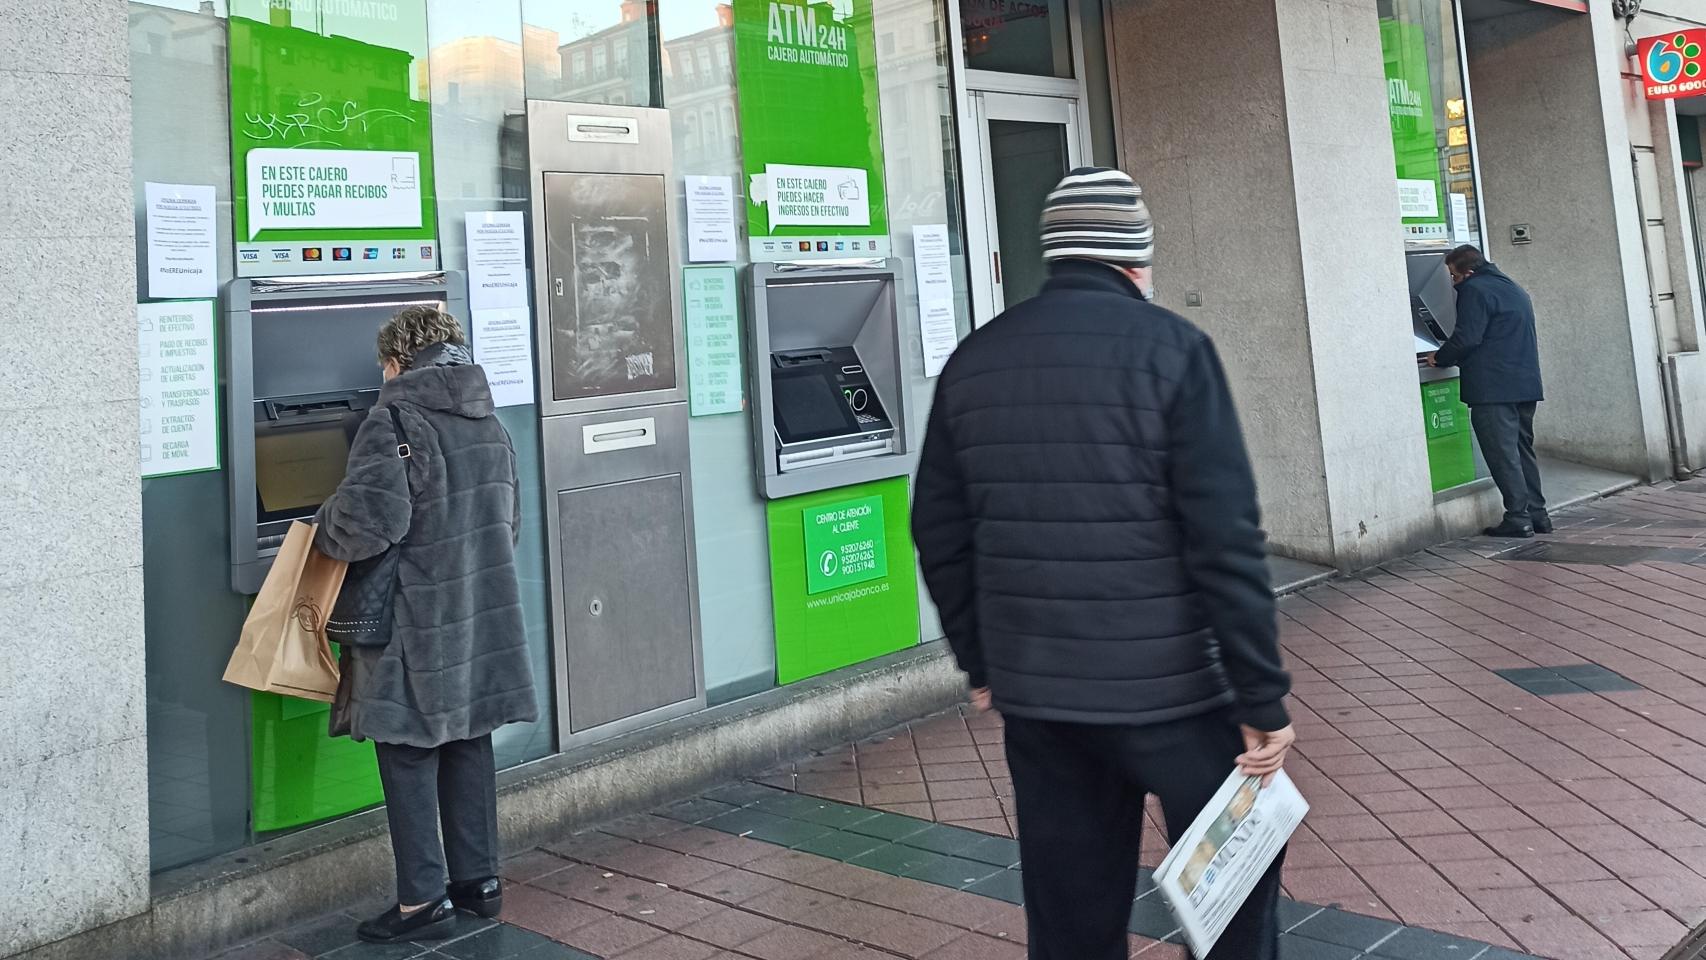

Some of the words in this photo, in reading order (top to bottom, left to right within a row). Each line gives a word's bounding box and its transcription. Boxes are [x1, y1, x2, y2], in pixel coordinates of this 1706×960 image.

[768, 2, 818, 47] ATM
[818, 24, 847, 51] 24H
[767, 46, 799, 63] CAJERO
[799, 50, 849, 68] AUTOMÁTICO
[1389, 77, 1410, 105] ATM
[1647, 83, 1678, 96] EURO
[261, 165, 279, 181] EN
[279, 166, 306, 181] ESTE
[308, 167, 348, 182] CAJERO
[776, 177, 786, 189] EN
[787, 178, 803, 190] ESTE
[803, 179, 827, 191] CAJERO
[262, 184, 305, 199] PUEDES
[307, 185, 342, 199] PAGAR
[345, 185, 388, 199] RECIBOS
[777, 191, 802, 203] PUEDES
[803, 192, 825, 203] HACER
[263, 202, 271, 216] Y
[273, 202, 316, 217] MULTAS
[778, 205, 810, 217] INGRESOS
[810, 205, 820, 217] EN
[820, 205, 849, 217] EFECTIVO
[159, 324, 168, 333] DE
[168, 323, 196, 332] EFECTIVO
[159, 340, 176, 349] PAGO
[176, 339, 184, 348] DE
[184, 338, 208, 348] RECIBOS
[164, 348, 197, 358] IMPUESTOS
[161, 374, 169, 383] DE
[169, 373, 197, 382] LIBRETAS
[161, 388, 210, 399] TRANSFERENCIAS
[162, 400, 167, 408] Y
[167, 399, 200, 408] TRASPASOS
[162, 415, 196, 425] EXTRACTOS
[162, 425, 170, 434] DE
[170, 423, 193, 433] CUENTA
[162, 440, 190, 450] RECARGA
[163, 451, 170, 459] DE
[815, 512, 838, 524] CENTRO
[838, 510, 846, 520] DE
[846, 504, 872, 518] ATENCIÓN
[832, 524, 839, 534] AL
[839, 520, 859, 532] CLIENTE
[840, 539, 874, 554] 952076260
[841, 550, 875, 565] 952076263
[842, 559, 876, 575] 900151948
[806, 582, 890, 608] www.unicajabanco.es
